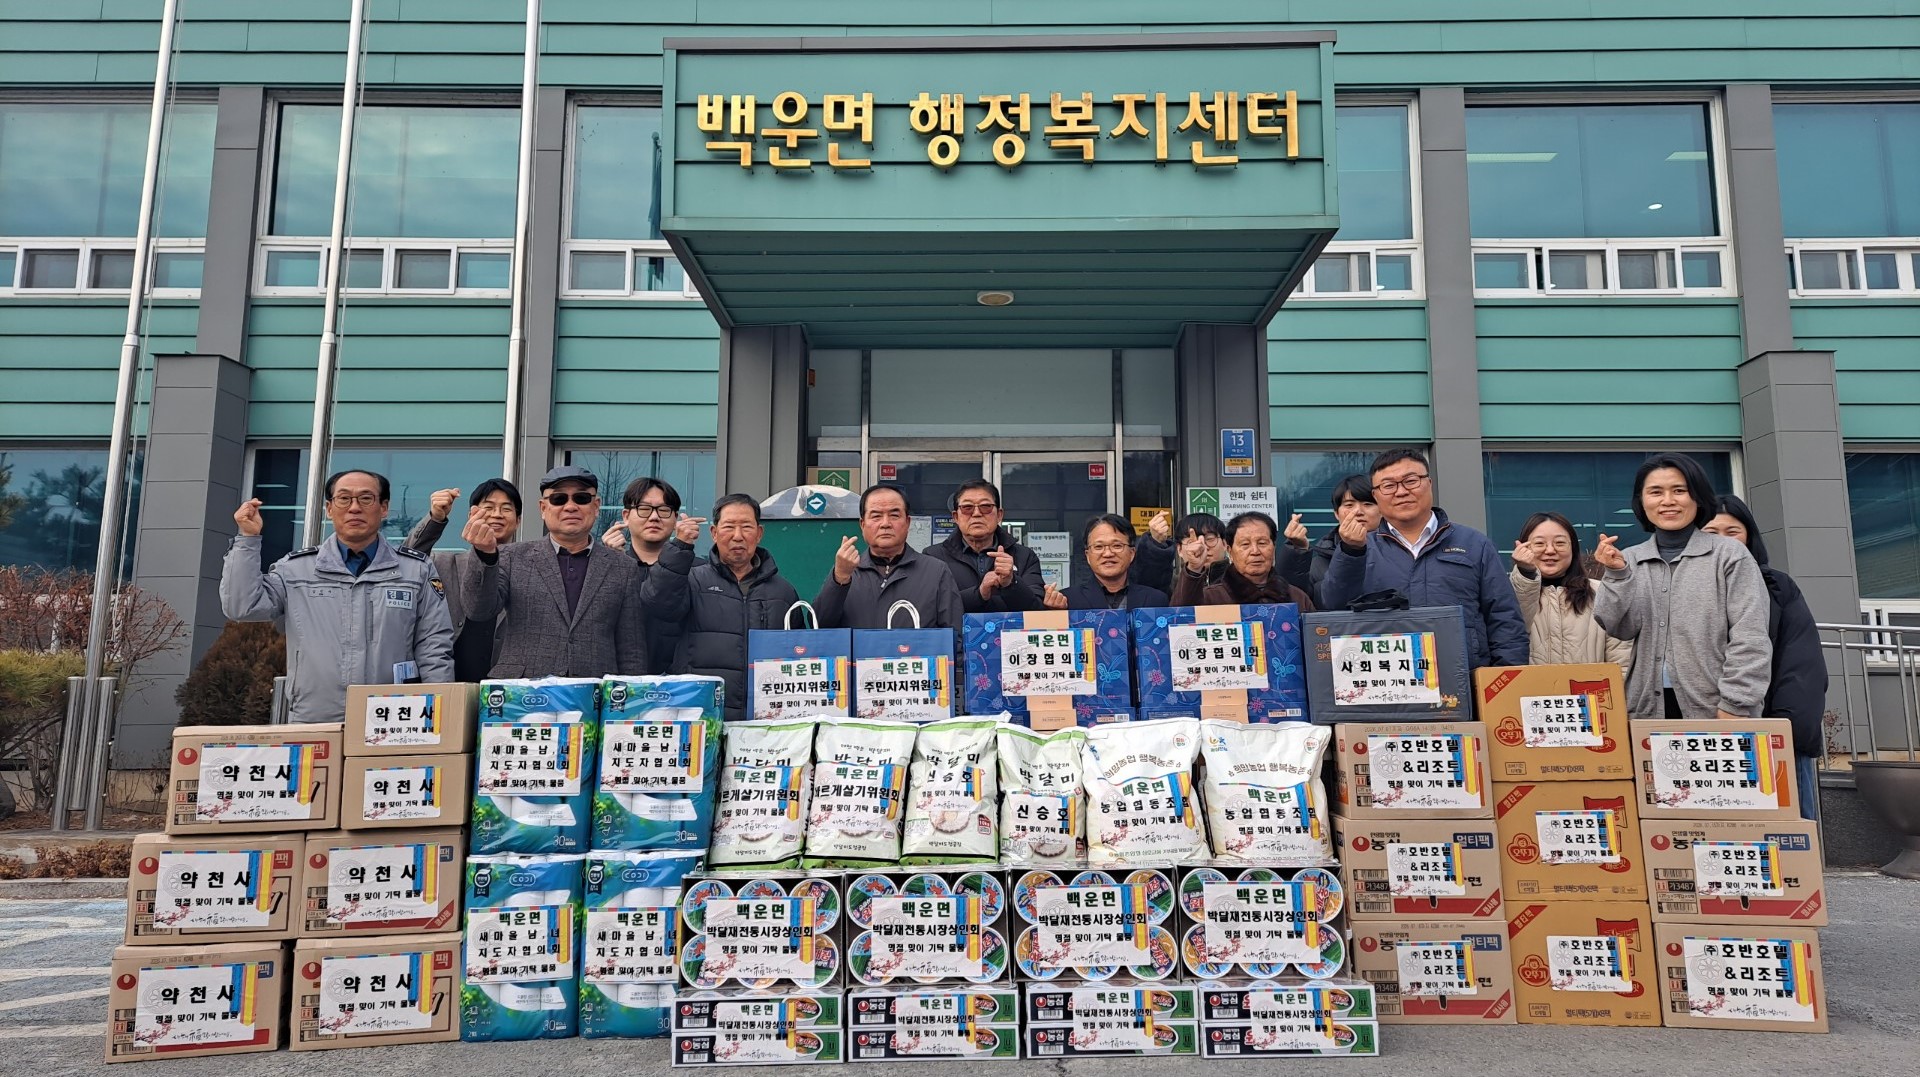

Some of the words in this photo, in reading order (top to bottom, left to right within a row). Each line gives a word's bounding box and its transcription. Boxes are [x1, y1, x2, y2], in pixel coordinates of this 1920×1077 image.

[697, 91, 873, 169] 백운면
[909, 90, 1298, 169] 행정복지센터
[1232, 435, 1244, 446] 13
[1230, 491, 1246, 500] 한파
[1251, 491, 1267, 500] 쉼터
[1196, 627, 1238, 640] 백운면
[1028, 634, 1069, 647] 백운면
[1360, 639, 1406, 654] 제천시
[1009, 653, 1089, 665] 이장협의회
[1178, 646, 1259, 660] 이장협의회
[781, 663, 822, 676] 백운면
[883, 662, 923, 674] 백운면
[1341, 659, 1430, 673] 사회복지과
[762, 680, 841, 695] 주민자치위원회
[864, 679, 942, 692] 주민자치위원회
[376, 707, 433, 721] 약천사
[511, 728, 551, 741] 백운면
[633, 726, 673, 739] 백운면
[1501, 730, 1521, 739] 오뚜기
[490, 760, 569, 771] 지도자협의회
[612, 758, 691, 768] 지도자협의회
[223, 765, 292, 781] 약천사
[733, 770, 776, 783] 백운면
[836, 767, 878, 780] 백운면
[1020, 768, 1074, 786] 박달미
[374, 779, 433, 795] 약천사
[1123, 781, 1165, 796] 백운면
[1673, 780, 1690, 788] 명절
[1695, 780, 1712, 788] 맞이
[1717, 780, 1734, 788] 기탁
[217, 791, 233, 799] 명절
[259, 791, 274, 799] 기탁
[1248, 789, 1292, 803] 백운면
[1017, 805, 1068, 821] 신승호
[181, 871, 251, 888] 약천사
[350, 864, 416, 883] 약천사
[1670, 882, 1694, 891] 가3487
[175, 898, 190, 906] 명절
[196, 898, 211, 906] 맞이
[1067, 891, 1115, 907] 백운면
[1237, 888, 1286, 904] 백운면
[738, 904, 784, 920] 백운면
[902, 902, 950, 917] 백운면
[499, 911, 540, 926] 백운면
[617, 912, 658, 926] 백운면
[1039, 914, 1146, 926] 박달재전통시장상인회
[1208, 911, 1318, 923] 박달재전통시장상인회
[707, 926, 813, 937] 박달재전통시장상인회
[873, 924, 979, 936] 박달재전통시장상인회
[1055, 934, 1070, 942] 명절
[1076, 934, 1091, 942] 맞이
[1096, 933, 1111, 942] 기탁
[479, 945, 560, 958] 지도자협의회
[596, 946, 676, 957] 지도자협의회
[888, 944, 904, 952] 명절
[1525, 971, 1546, 979] 오뚜기
[344, 974, 412, 993] 약천사
[161, 985, 234, 1004] 약천사
[1097, 992, 1129, 1003] 백운면
[1708, 987, 1725, 995] 명절
[1730, 987, 1747, 996] 맞이
[1753, 989, 1770, 997] 기탁
[920, 999, 952, 1009] 백운면
[1047, 998, 1063, 1006] 농심
[1221, 996, 1238, 1004] 농심
[1274, 993, 1307, 1004] 백운면
[693, 1004, 709, 1014] 농심
[741, 1005, 773, 1015] 백운면
[869, 1002, 886, 1010] 농심
[898, 1015, 975, 1024] 박달재전통시장상인회
[1253, 1010, 1331, 1019] 박달재전통시장상인회
[543, 1020, 555, 1031] 30
[719, 1021, 794, 1029] 박달재전통시장상인회
[1047, 1033, 1064, 1041] 농심
[1223, 1032, 1240, 1040] 농심
[693, 1040, 709, 1049] 농심
